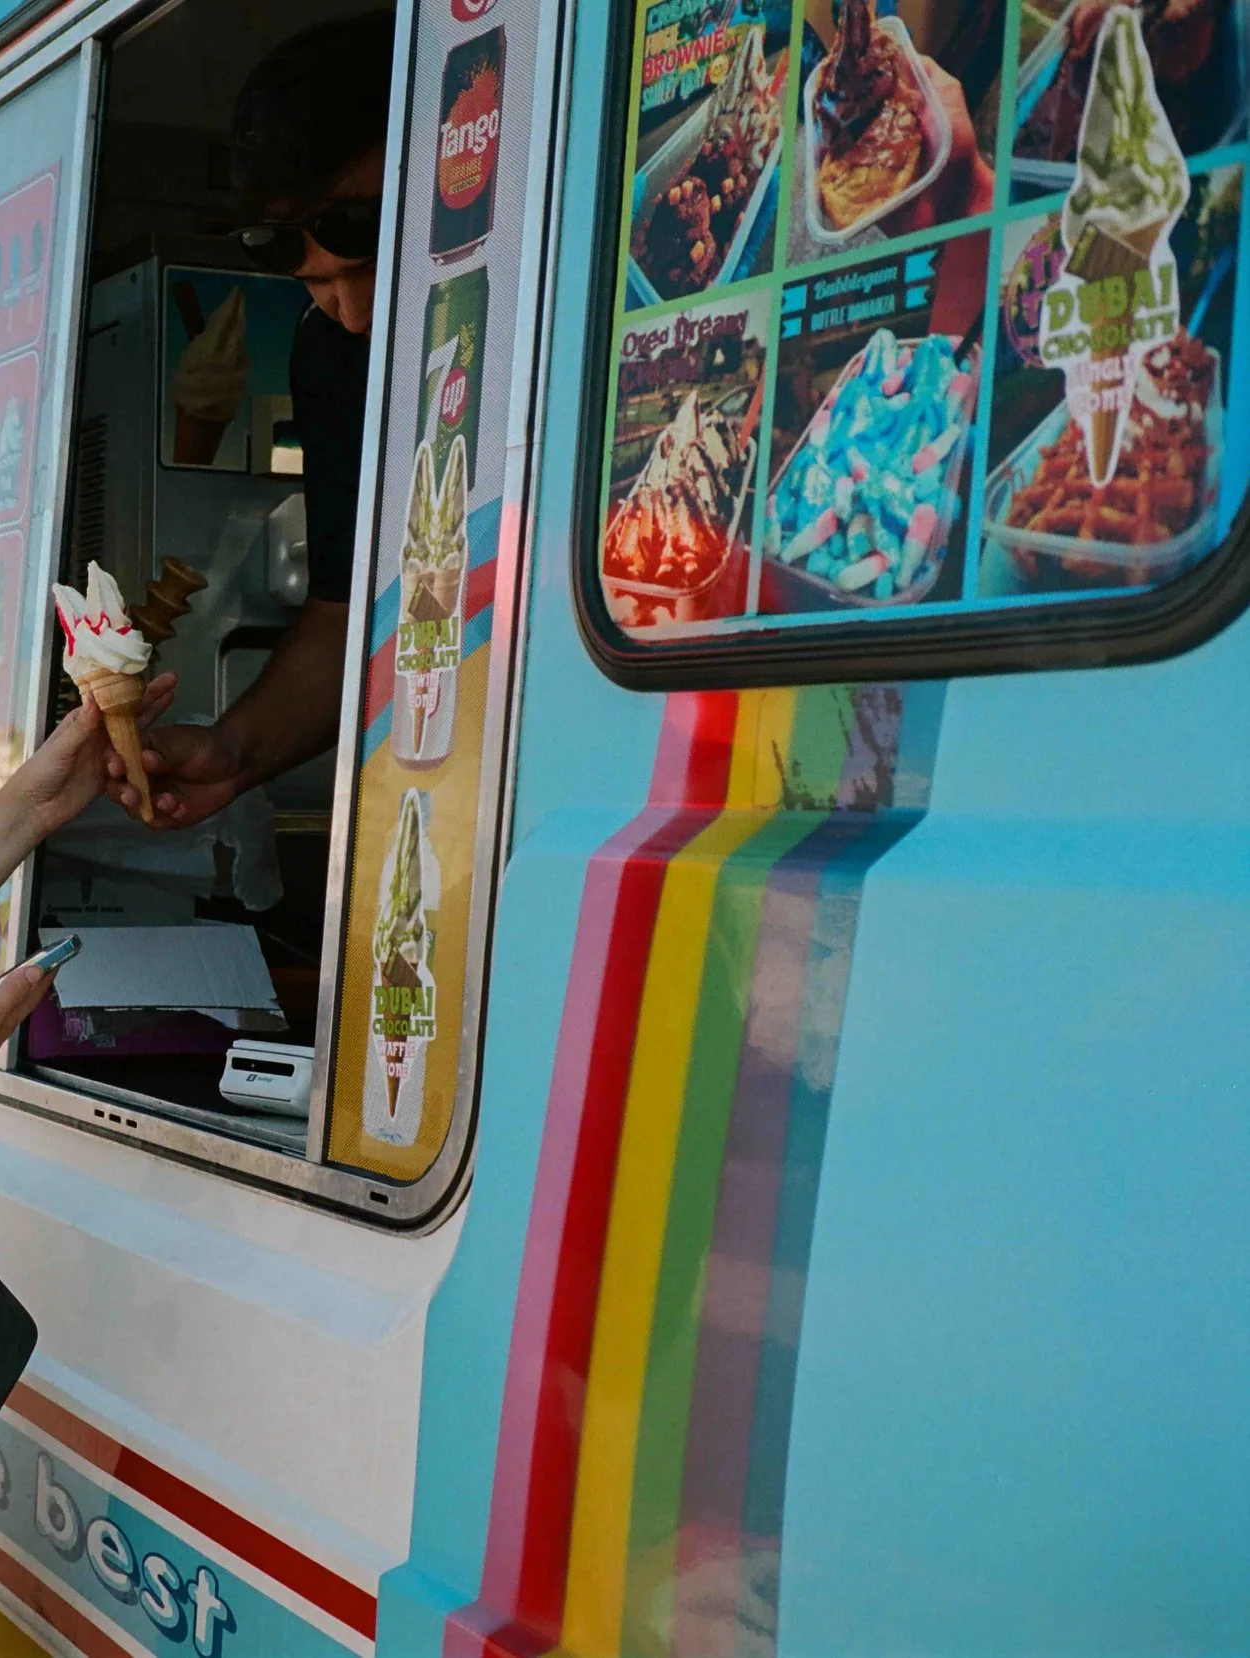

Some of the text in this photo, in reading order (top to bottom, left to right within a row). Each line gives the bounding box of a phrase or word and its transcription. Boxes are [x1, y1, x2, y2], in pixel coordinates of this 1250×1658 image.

[440, 108, 499, 161] Tango
[1045, 263, 1174, 330] DUBAI
[621, 309, 749, 358] Oreo Dreamy
[1043, 312, 1174, 361] CHOCOLATE
[1070, 388, 1129, 413] CONE
[398, 616, 460, 653] DUBAI
[396, 648, 459, 673] CHOCOLATE
[374, 986, 434, 1017] DUBAI
[372, 1018, 435, 1037] CHOCOLATE
[377, 1041, 418, 1057] WAFFLE
[383, 1062, 410, 1078] CONE
[34, 1450, 238, 1658] best
